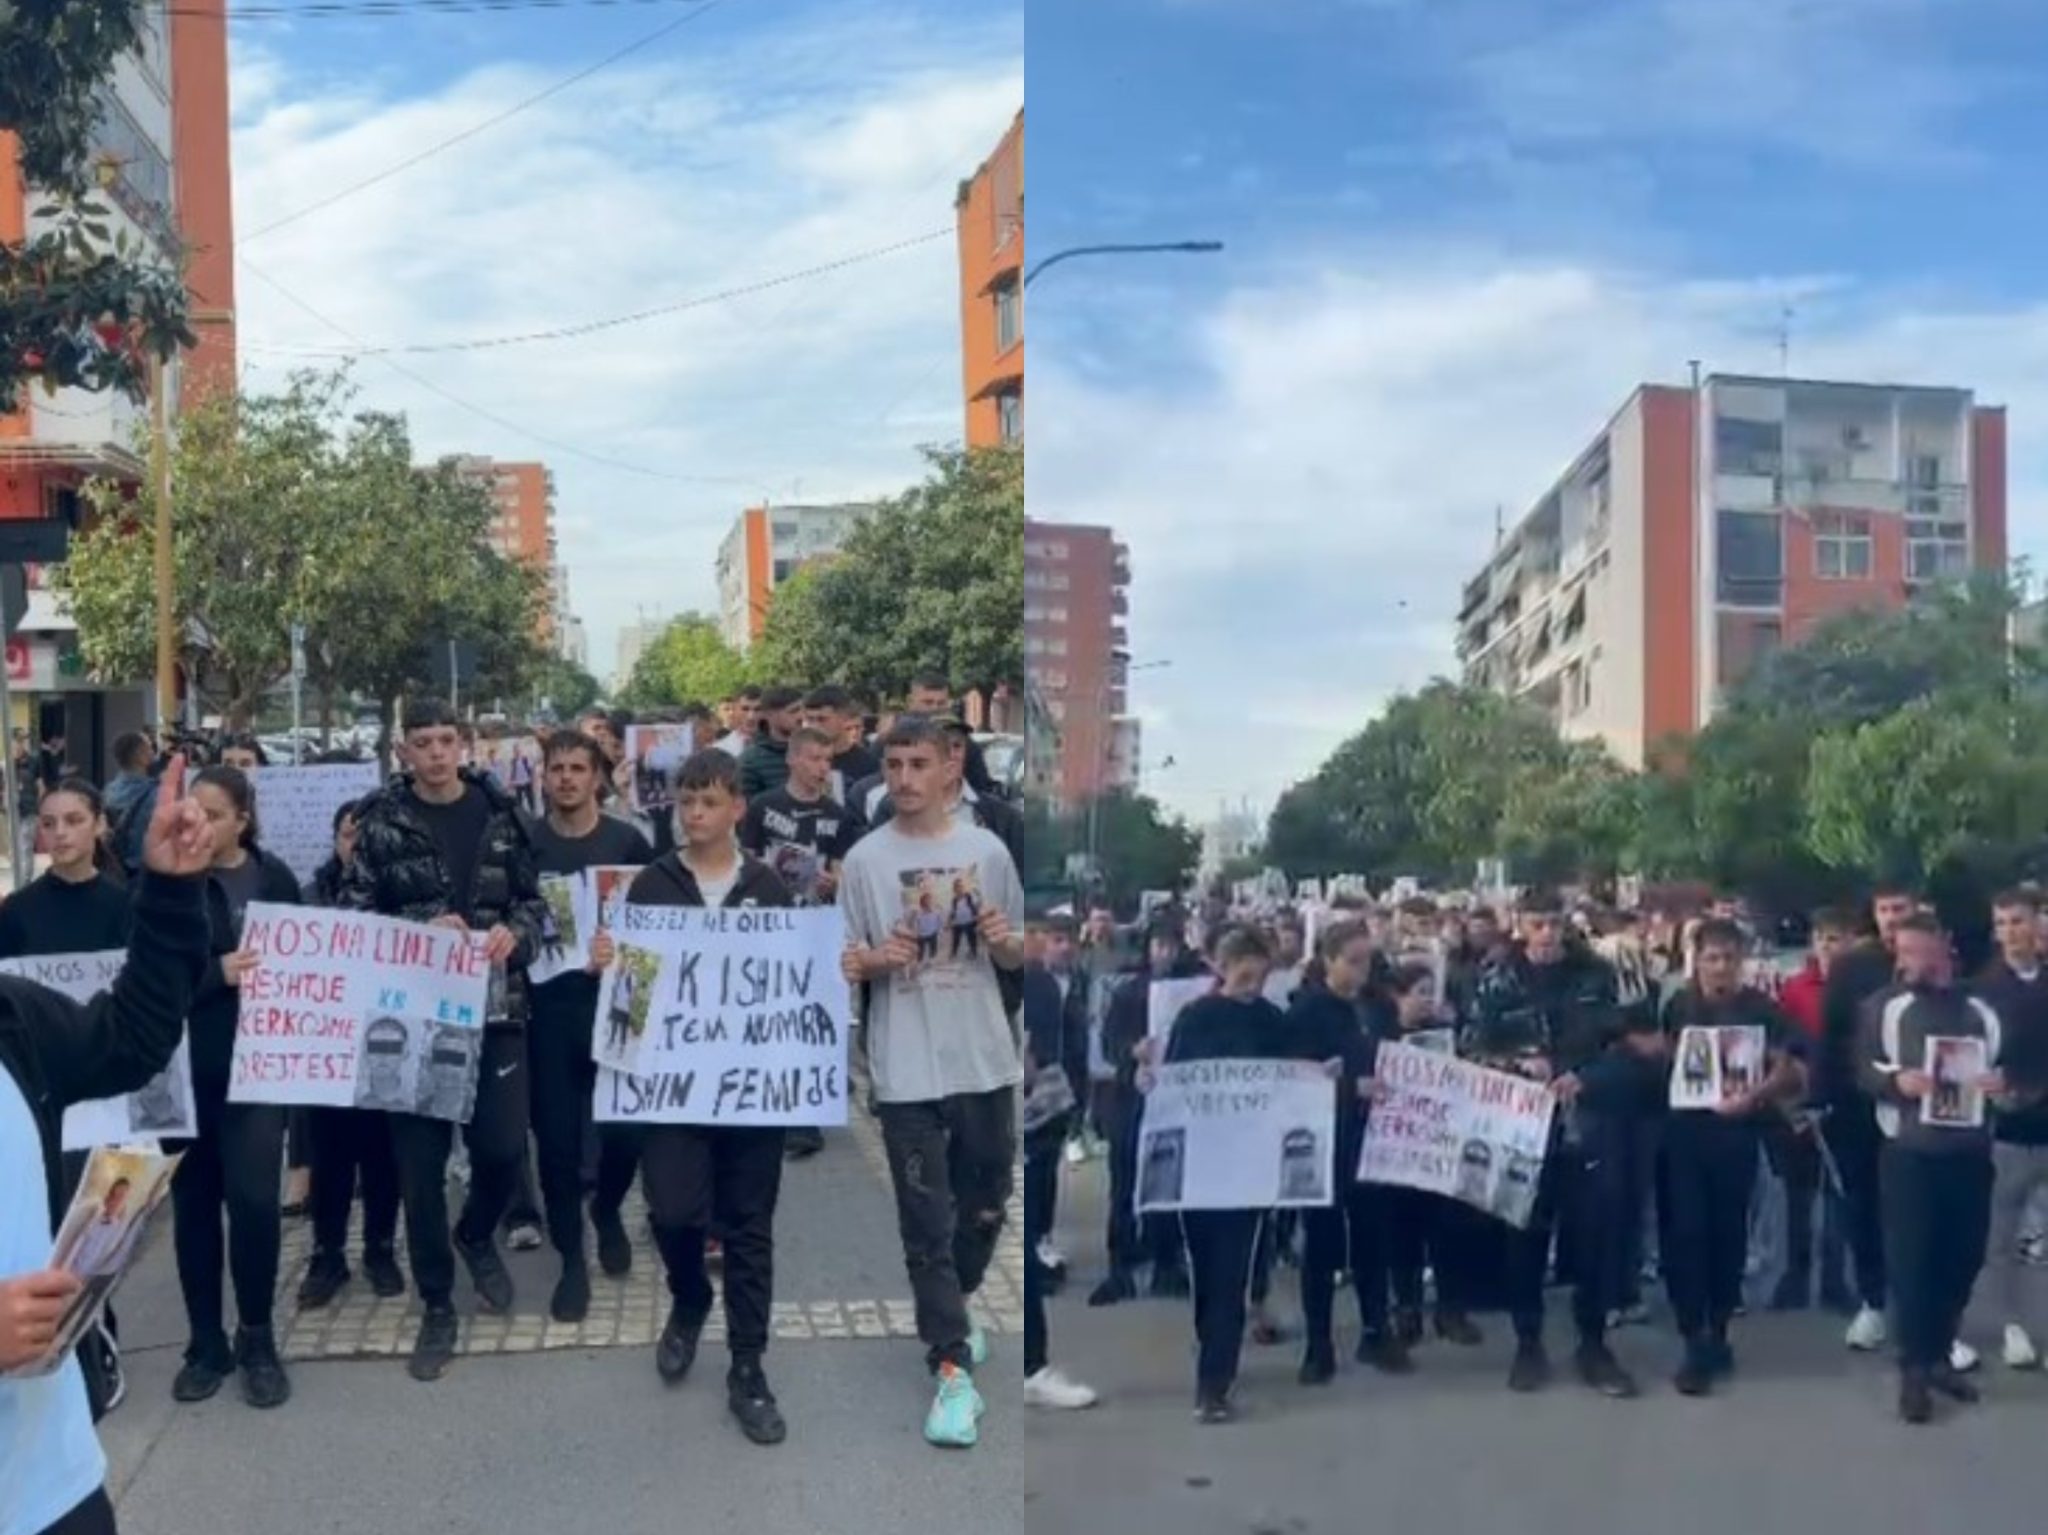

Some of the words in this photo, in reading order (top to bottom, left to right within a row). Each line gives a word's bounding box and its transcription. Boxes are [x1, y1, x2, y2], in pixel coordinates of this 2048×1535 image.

[246, 918, 322, 956] MOS
[373, 928, 434, 968] LINI
[242, 968, 347, 1003] HESHTJE
[657, 1013, 729, 1051] TEM
[713, 1064, 840, 1118] FEMIJE
